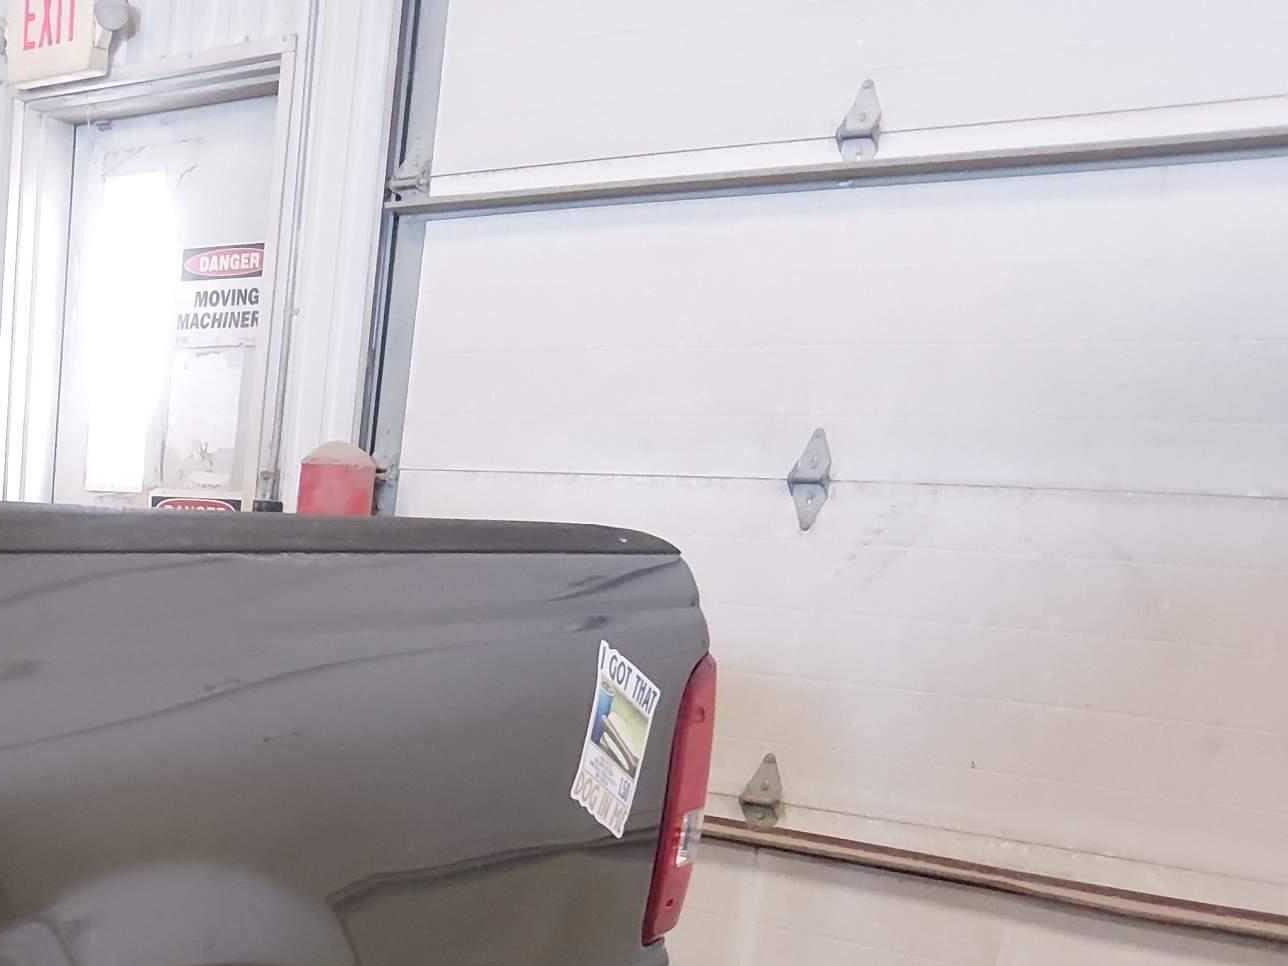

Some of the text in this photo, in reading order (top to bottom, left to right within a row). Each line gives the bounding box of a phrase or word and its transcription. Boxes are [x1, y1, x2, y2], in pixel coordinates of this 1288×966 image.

[199, 252, 260, 273] DANGER
[194, 287, 260, 308] MOVING
[601, 646, 658, 715] I GOT THAT
[573, 770, 600, 810] DOG
